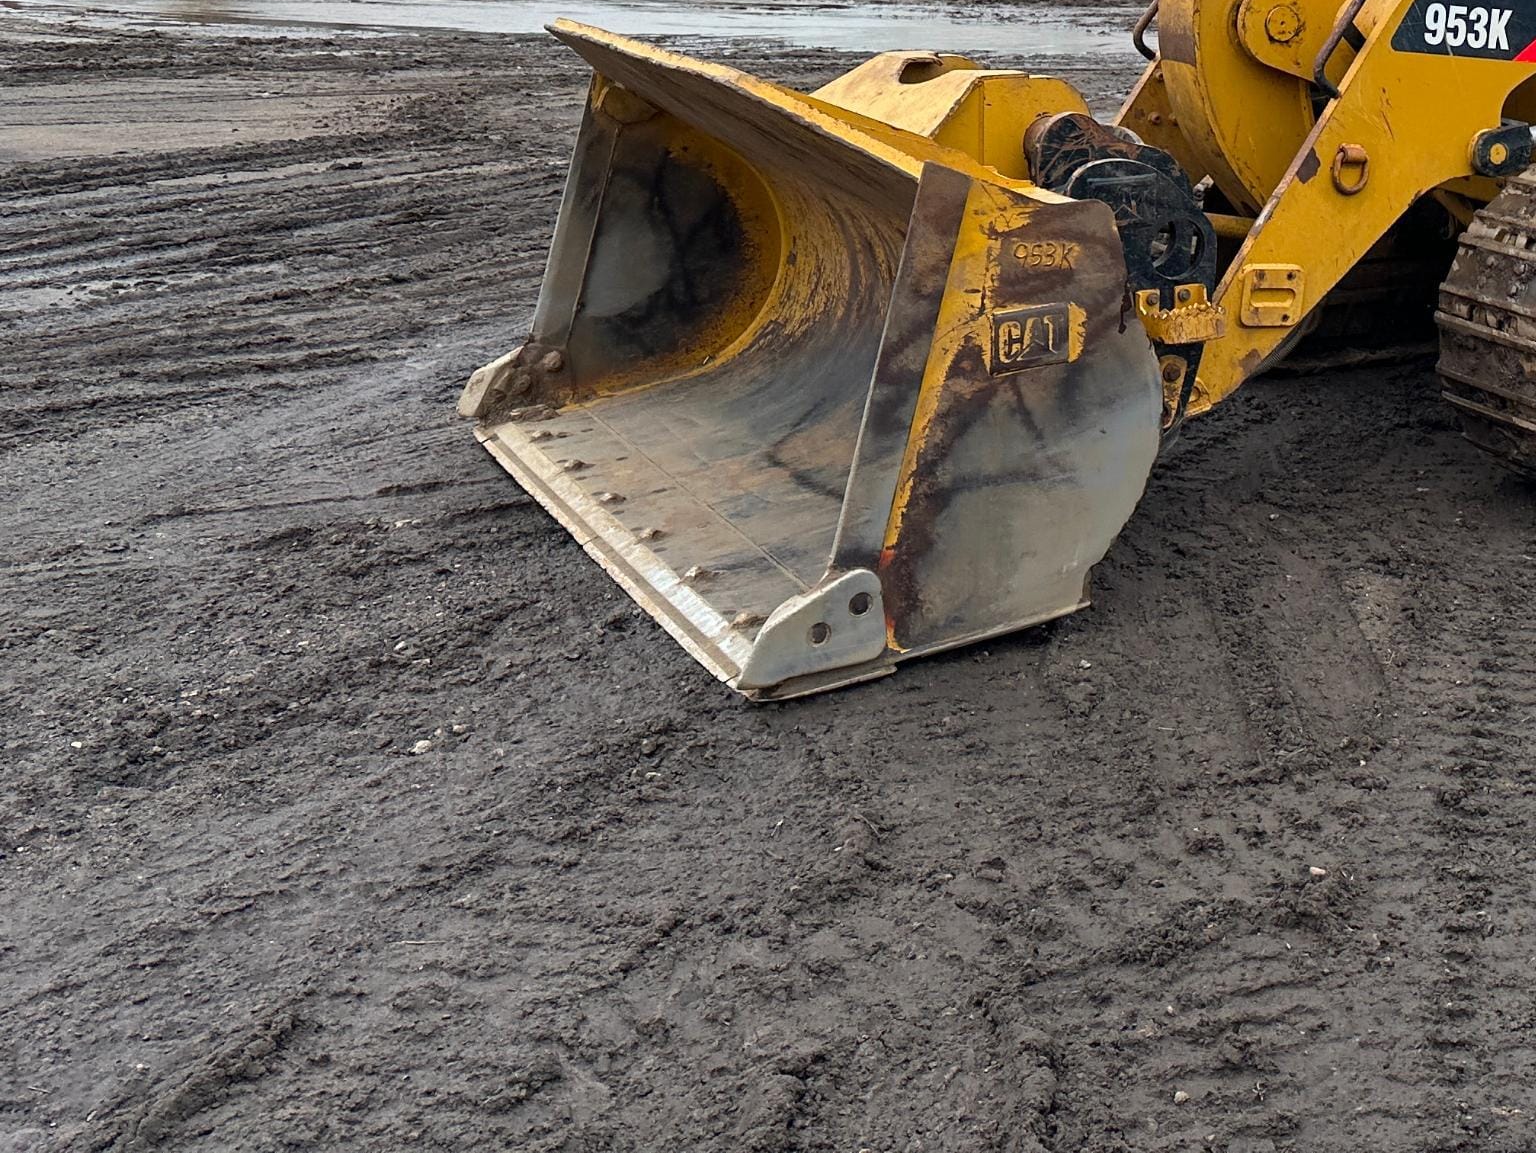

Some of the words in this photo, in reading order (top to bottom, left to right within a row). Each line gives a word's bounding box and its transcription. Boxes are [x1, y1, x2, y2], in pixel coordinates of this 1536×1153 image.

[1424, 3, 1513, 50] 953K
[1013, 242, 1075, 270] 953K
[998, 313, 1066, 364] CAT
